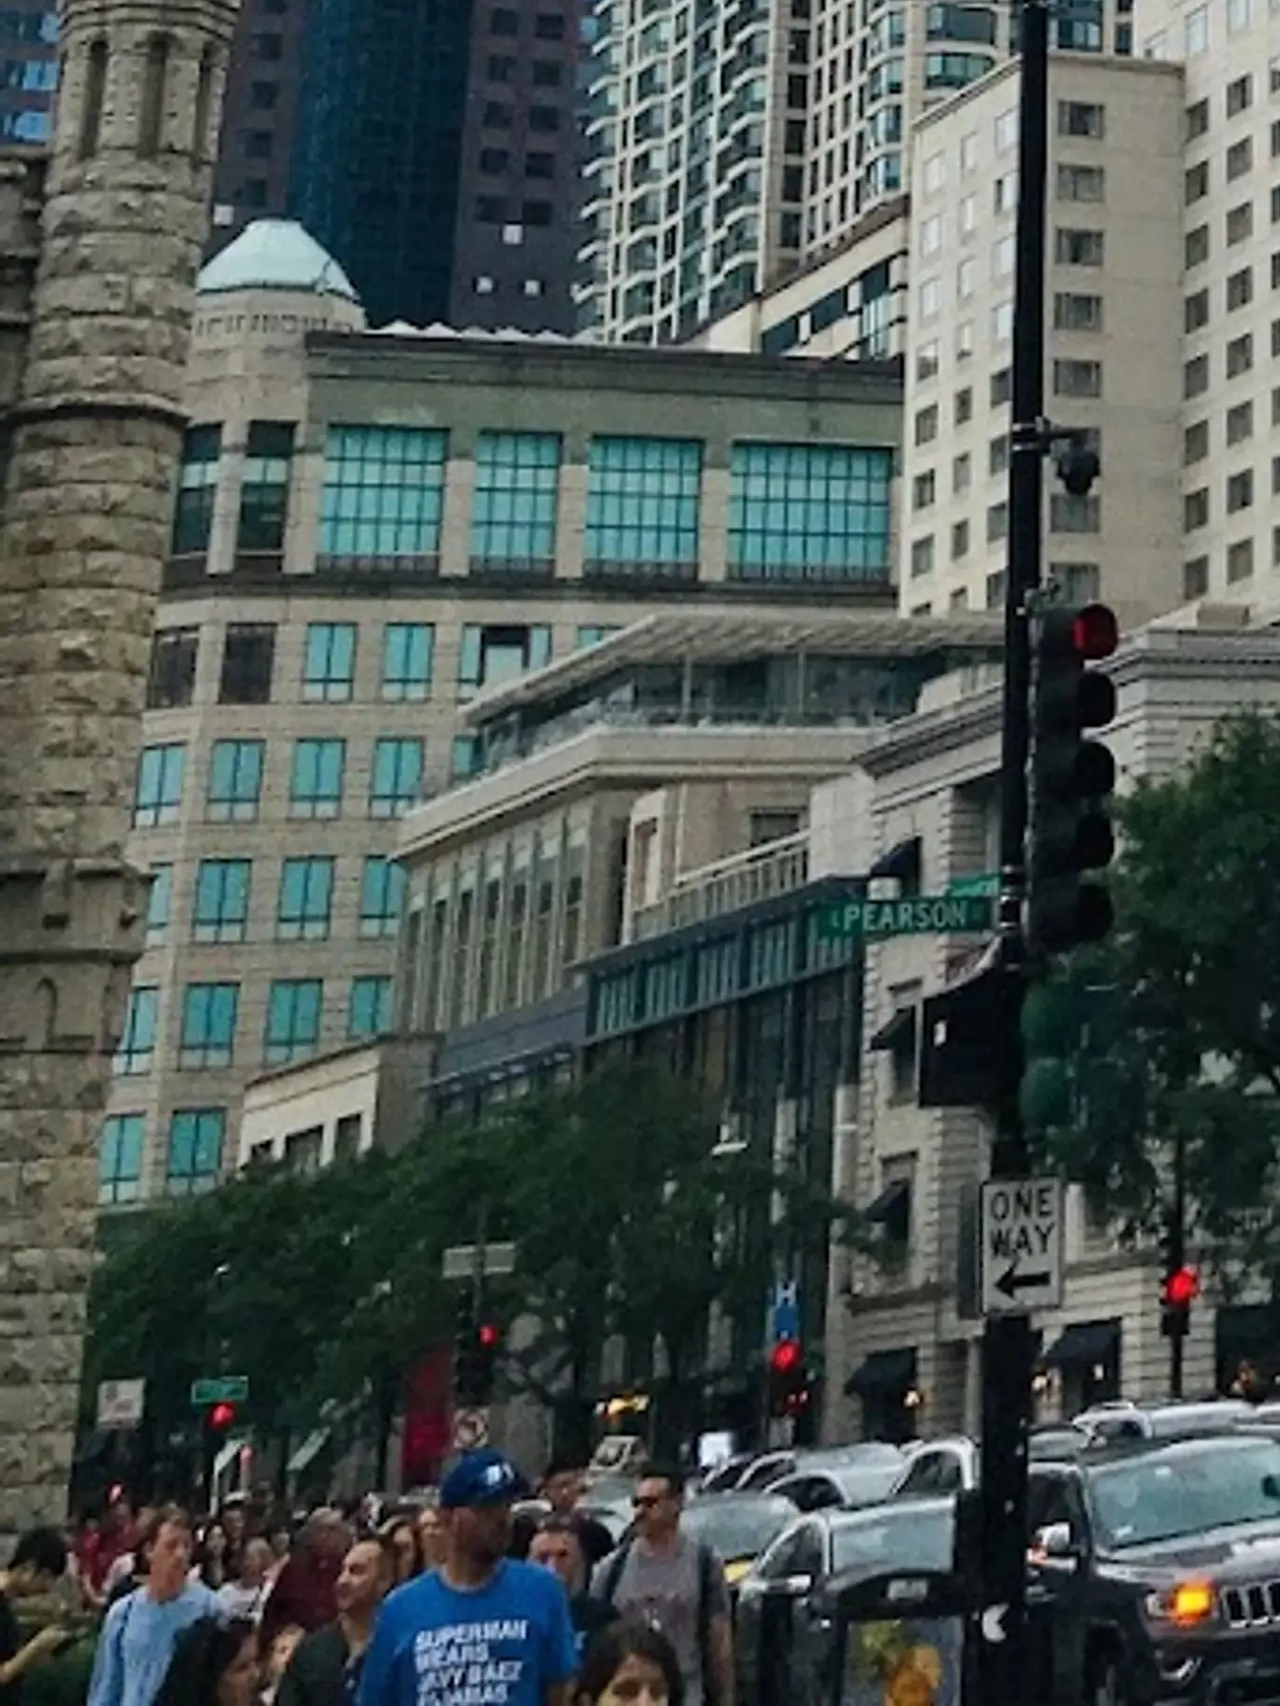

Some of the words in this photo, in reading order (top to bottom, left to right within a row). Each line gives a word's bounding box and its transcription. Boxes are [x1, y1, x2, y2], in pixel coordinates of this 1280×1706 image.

[843, 900, 968, 931] PEARSON
[990, 1187, 1053, 1222] ONE
[991, 1222, 1054, 1258] WAY
[415, 1619, 528, 1653] SUPERMAN
